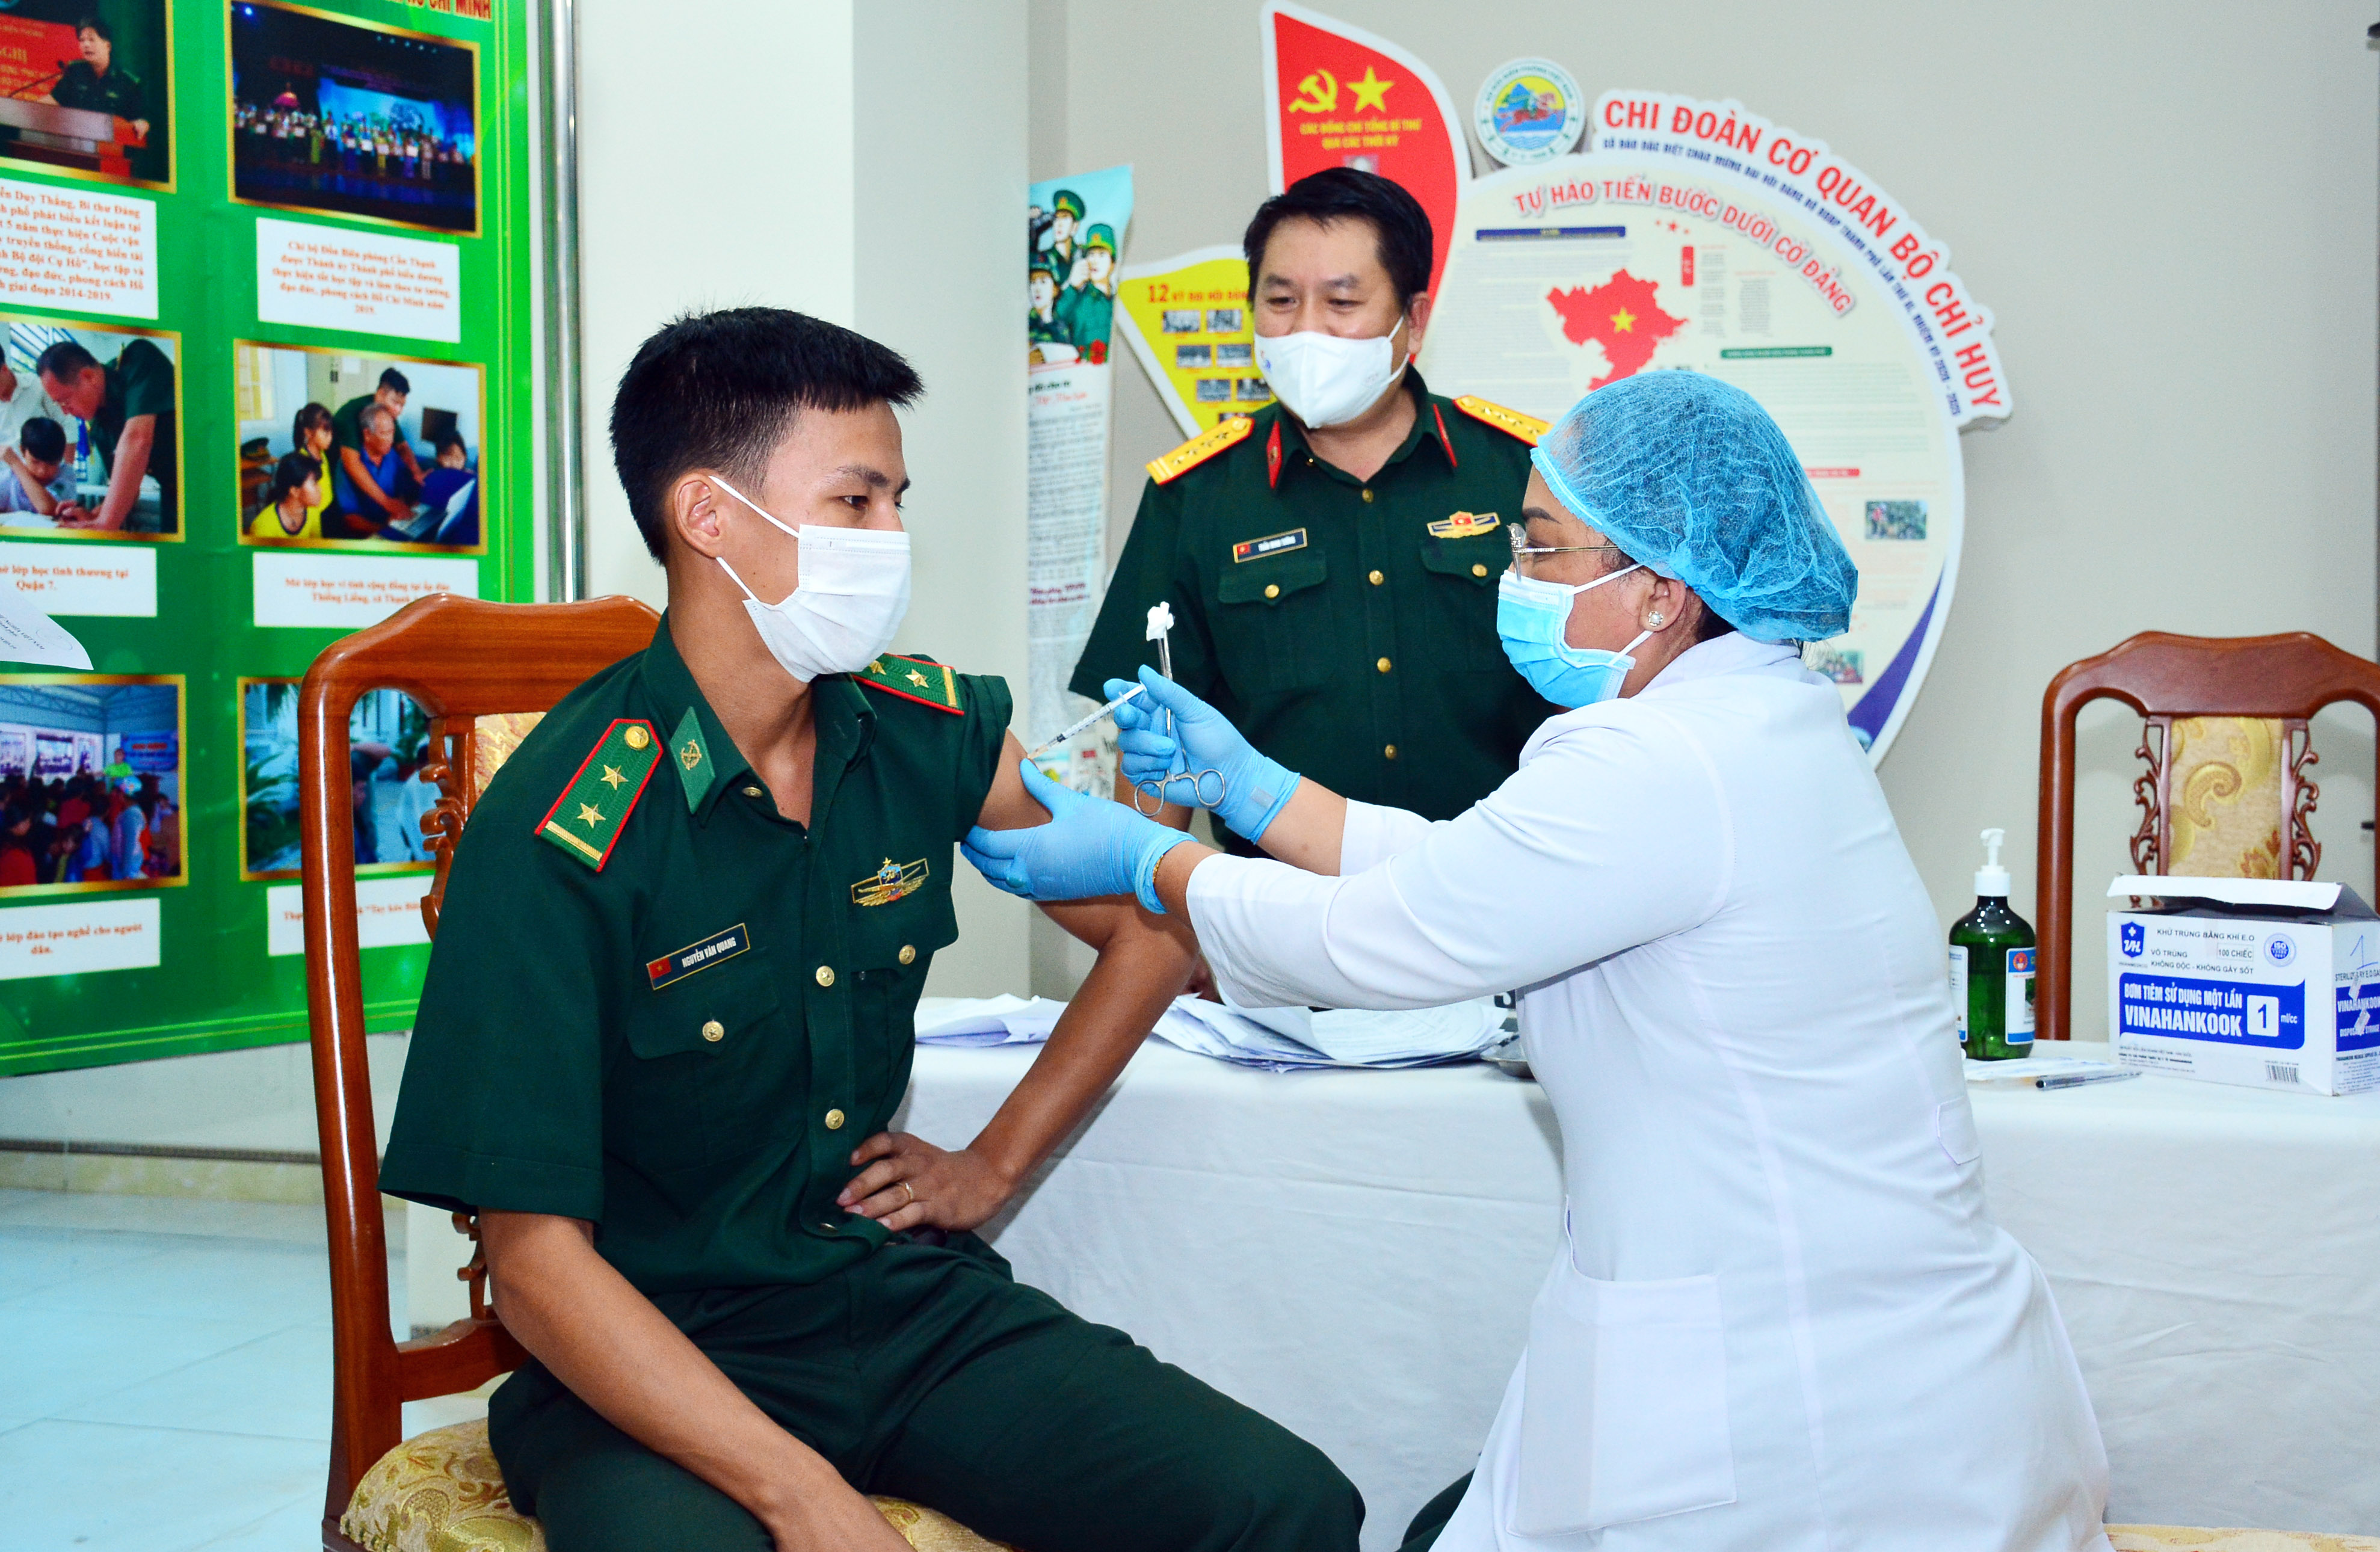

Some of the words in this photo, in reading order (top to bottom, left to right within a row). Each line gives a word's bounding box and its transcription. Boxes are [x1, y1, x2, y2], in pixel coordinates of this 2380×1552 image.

[16, 191, 35, 204] Duy
[40, 195, 76, 209] Thắng,
[94, 202, 111, 213] thư
[114, 205, 140, 219] Đảng
[10, 205, 29, 216] phố
[33, 211, 56, 220] phát
[60, 212, 81, 224] biểu
[85, 215, 101, 226] kết
[103, 218, 125, 230] luận
[129, 223, 141, 233] tại
[7, 220, 13, 228] 5
[16, 222, 39, 233] năm
[42, 225, 64, 237] thực
[68, 228, 90, 241] hiện
[93, 231, 118, 244] Cuộc
[122, 236, 140, 247] vận
[1513, 186, 1543, 212] TỰ
[1550, 178, 1595, 203] HÀO
[1603, 174, 1651, 201] TIẾN
[1659, 185, 1719, 217] BƯỚC
[1722, 205, 1774, 244] DƯỚI
[1775, 236, 1808, 263] CỜ
[1802, 259, 1851, 312] ĐẢNG
[7, 236, 41, 249] truyền
[44, 239, 76, 254] thống,
[79, 243, 103, 258] cống
[106, 247, 127, 259] hiến
[131, 251, 143, 261] tài
[1605, 99, 1660, 131] CHI
[1671, 106, 1763, 155] ĐOÀN
[1768, 138, 1819, 176] CƠ
[1816, 166, 1898, 239] QUAN
[1889, 233, 1940, 282] BỘ
[1925, 282, 1984, 339] CHỈ
[1955, 342, 2002, 407] HUY
[12, 251, 25, 263] Bộ
[29, 253, 45, 264] đội
[48, 254, 63, 267] Cụ
[93, 261, 110, 273] học
[114, 264, 131, 276] tập
[134, 267, 144, 276] và
[8, 282, 28, 292] giai
[31, 283, 55, 297] đoạn
[22, 268, 41, 279] đạo
[43, 270, 66, 283] đức,
[69, 274, 101, 287] phong
[104, 277, 126, 288] cách
[129, 279, 144, 290] Hồ
[1149, 284, 1169, 303] 12
[12, 565, 28, 576] lớp
[32, 566, 49, 577] học
[52, 565, 73, 576] tình
[76, 567, 113, 579] thương
[116, 569, 129, 579] tại
[16, 580, 46, 591] Quận
[7, 933, 23, 943] lớp
[48, 931, 64, 940] tạo
[94, 925, 111, 935] cho
[114, 922, 143, 936] người
[2156, 928, 2172, 936] KHỬ
[2203, 931, 2225, 940] BẰNG
[703, 945, 717, 958] VĂN
[717, 937, 737, 953] QUANG
[2218, 949, 2230, 958] 100
[2231, 947, 2252, 959] CHIẾC
[2151, 960, 2175, 969] KHÔNG
[2176, 962, 2191, 971] ĐỘC
[2196, 963, 2221, 973] KHÔNG
[2124, 982, 2142, 999] BƠM
[2143, 982, 2163, 1002] TIÊM
[2165, 981, 2178, 1003] SỬ
[2178, 988, 2203, 1008] DỤNG
[2204, 988, 2223, 1010] MỘT
[2124, 1005, 2243, 1038] VINAHANKOOK
[2257, 1003, 2267, 1029] 1
[2280, 1012, 2298, 1024] ml/cc
